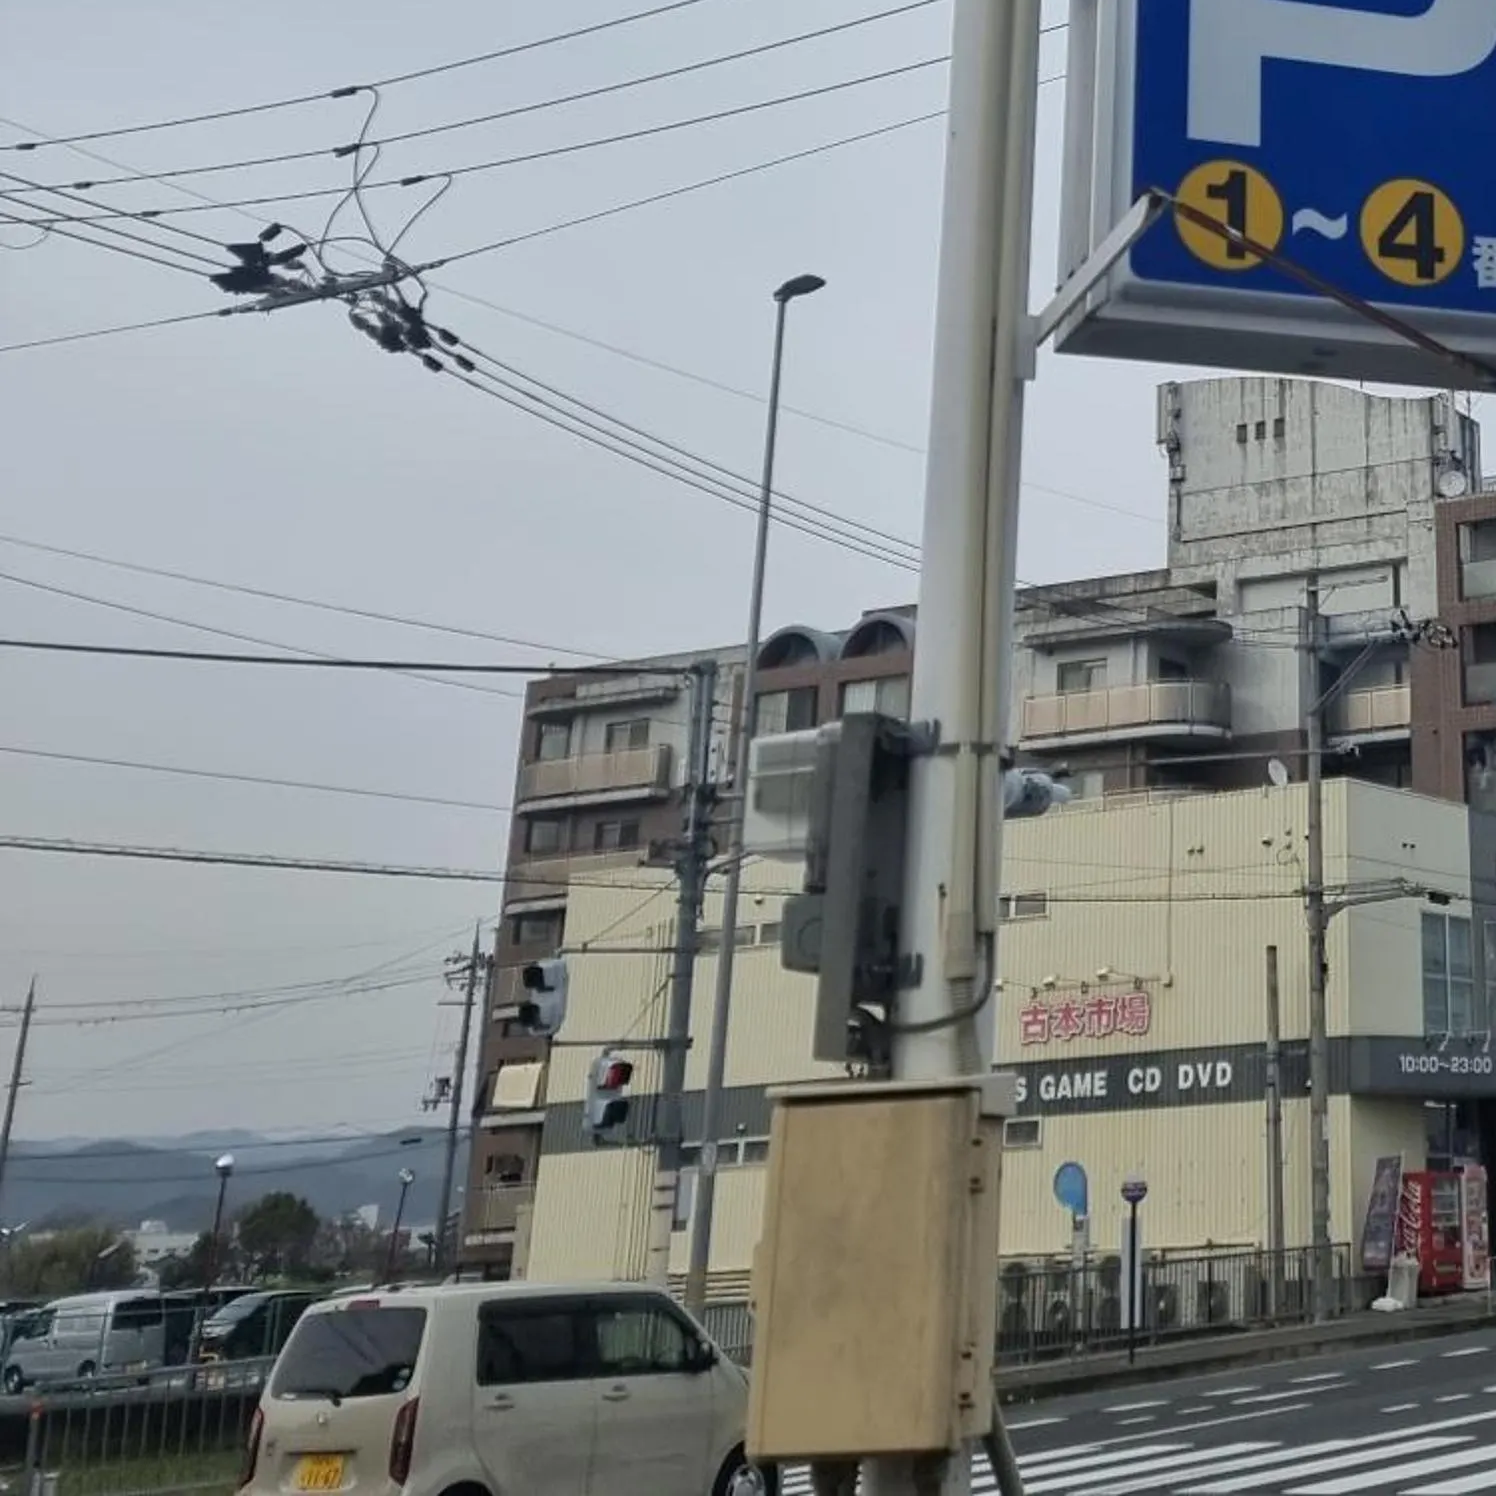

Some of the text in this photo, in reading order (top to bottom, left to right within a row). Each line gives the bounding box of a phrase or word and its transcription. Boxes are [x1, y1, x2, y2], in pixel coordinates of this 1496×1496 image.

[1019, 991, 1152, 1045] 古本市場
[1040, 1070, 1107, 1100] GAME
[1128, 1064, 1161, 1094] CD
[1178, 1060, 1233, 1090] DVD
